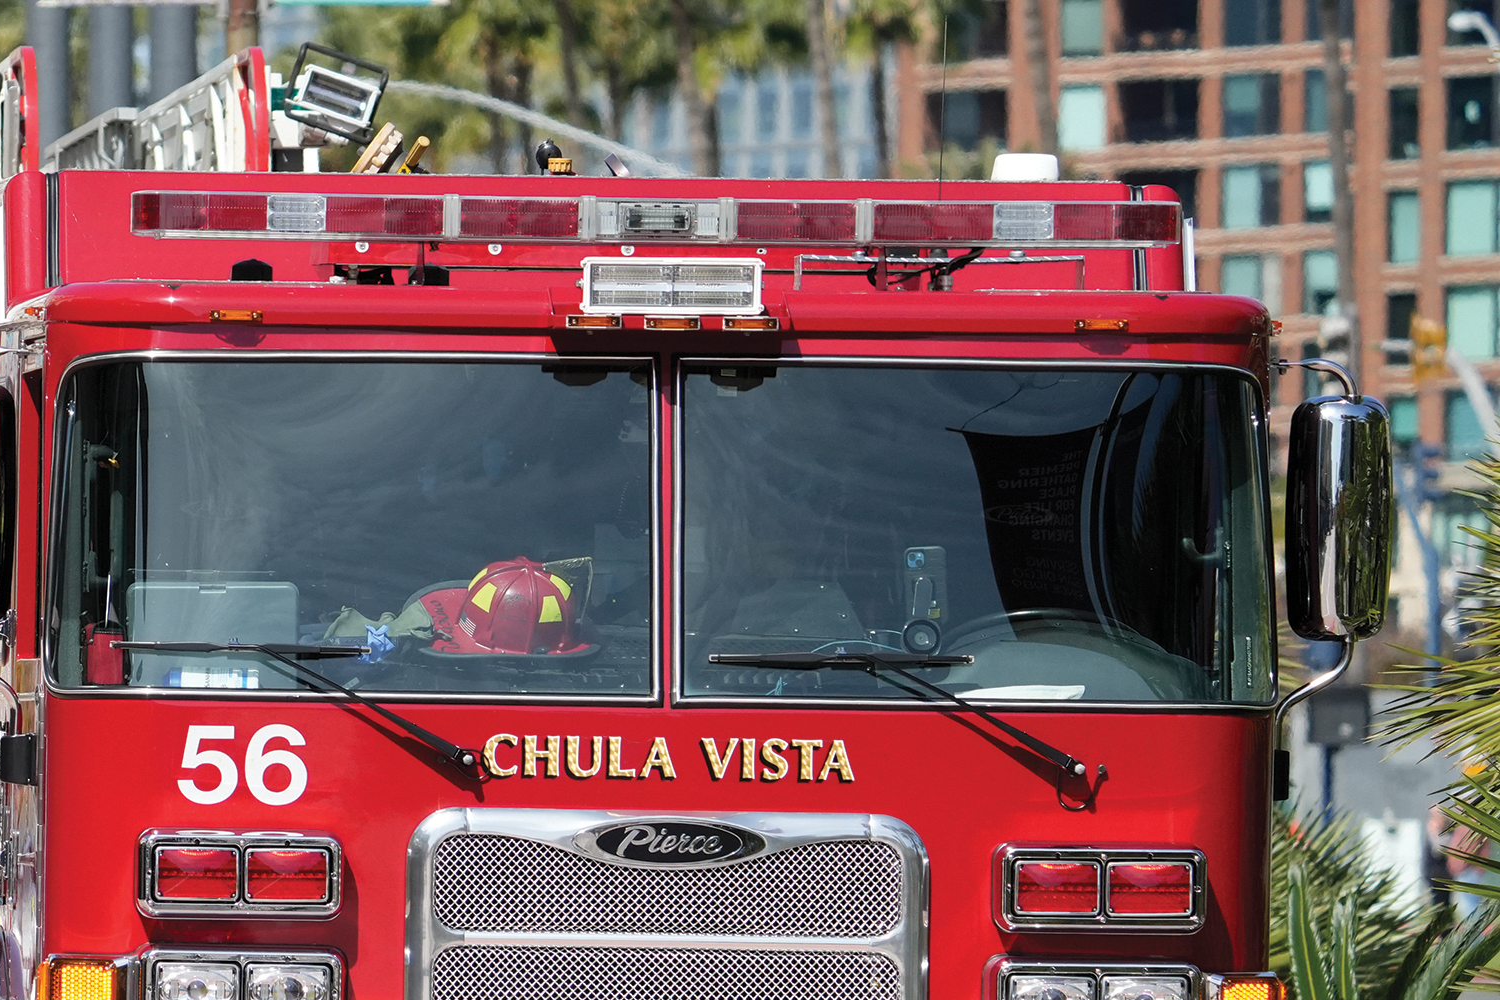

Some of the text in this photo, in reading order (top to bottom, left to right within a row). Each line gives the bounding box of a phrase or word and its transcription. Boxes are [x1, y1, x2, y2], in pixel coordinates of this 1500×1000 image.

[177, 723, 308, 806] 56
[482, 733, 855, 783] CHULA VISTA
[615, 824, 723, 857] Pierce
